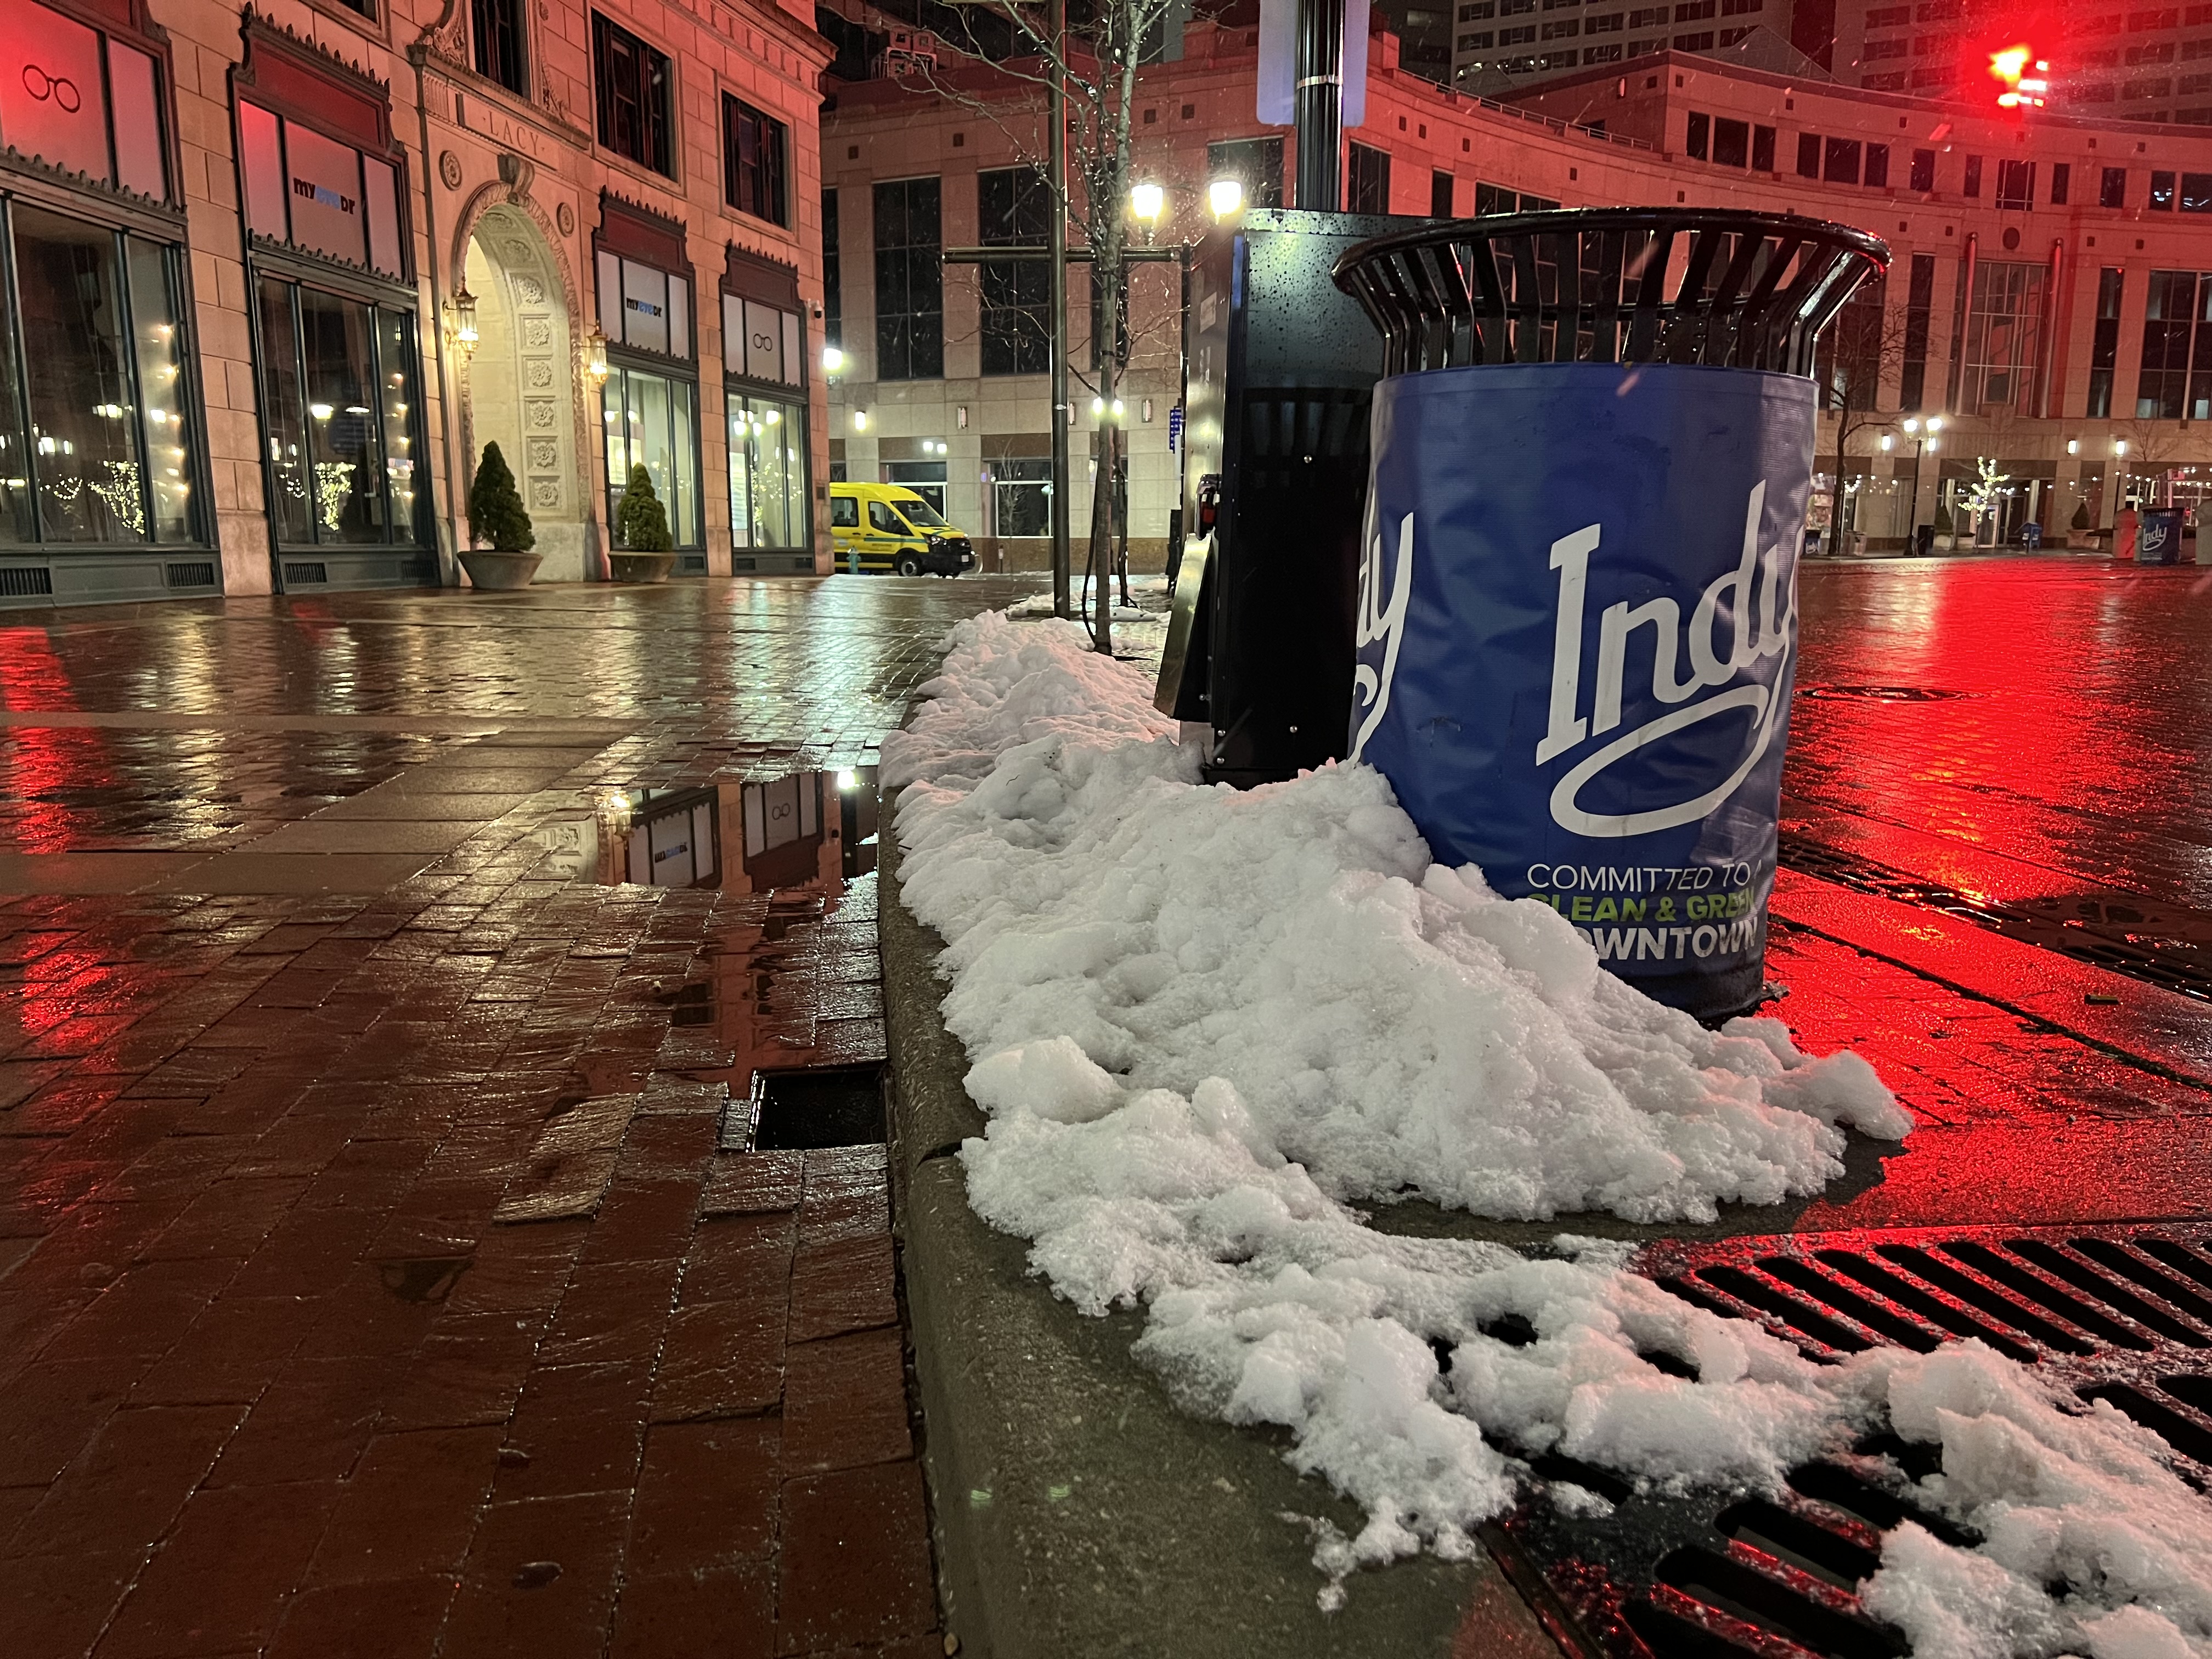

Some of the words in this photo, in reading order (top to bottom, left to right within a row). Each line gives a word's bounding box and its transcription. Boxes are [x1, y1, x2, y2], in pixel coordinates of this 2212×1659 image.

[488, 110, 539, 156] LACY
[2142, 523, 2167, 551] Indy
[1536, 479, 1804, 837] Indy
[1527, 863, 1713, 892] COMMITTED
[1722, 861, 1751, 887] TO
[1527, 893, 1646, 922] LEAN
[1655, 896, 1677, 922] &
[1686, 886, 1755, 921] GREEN
